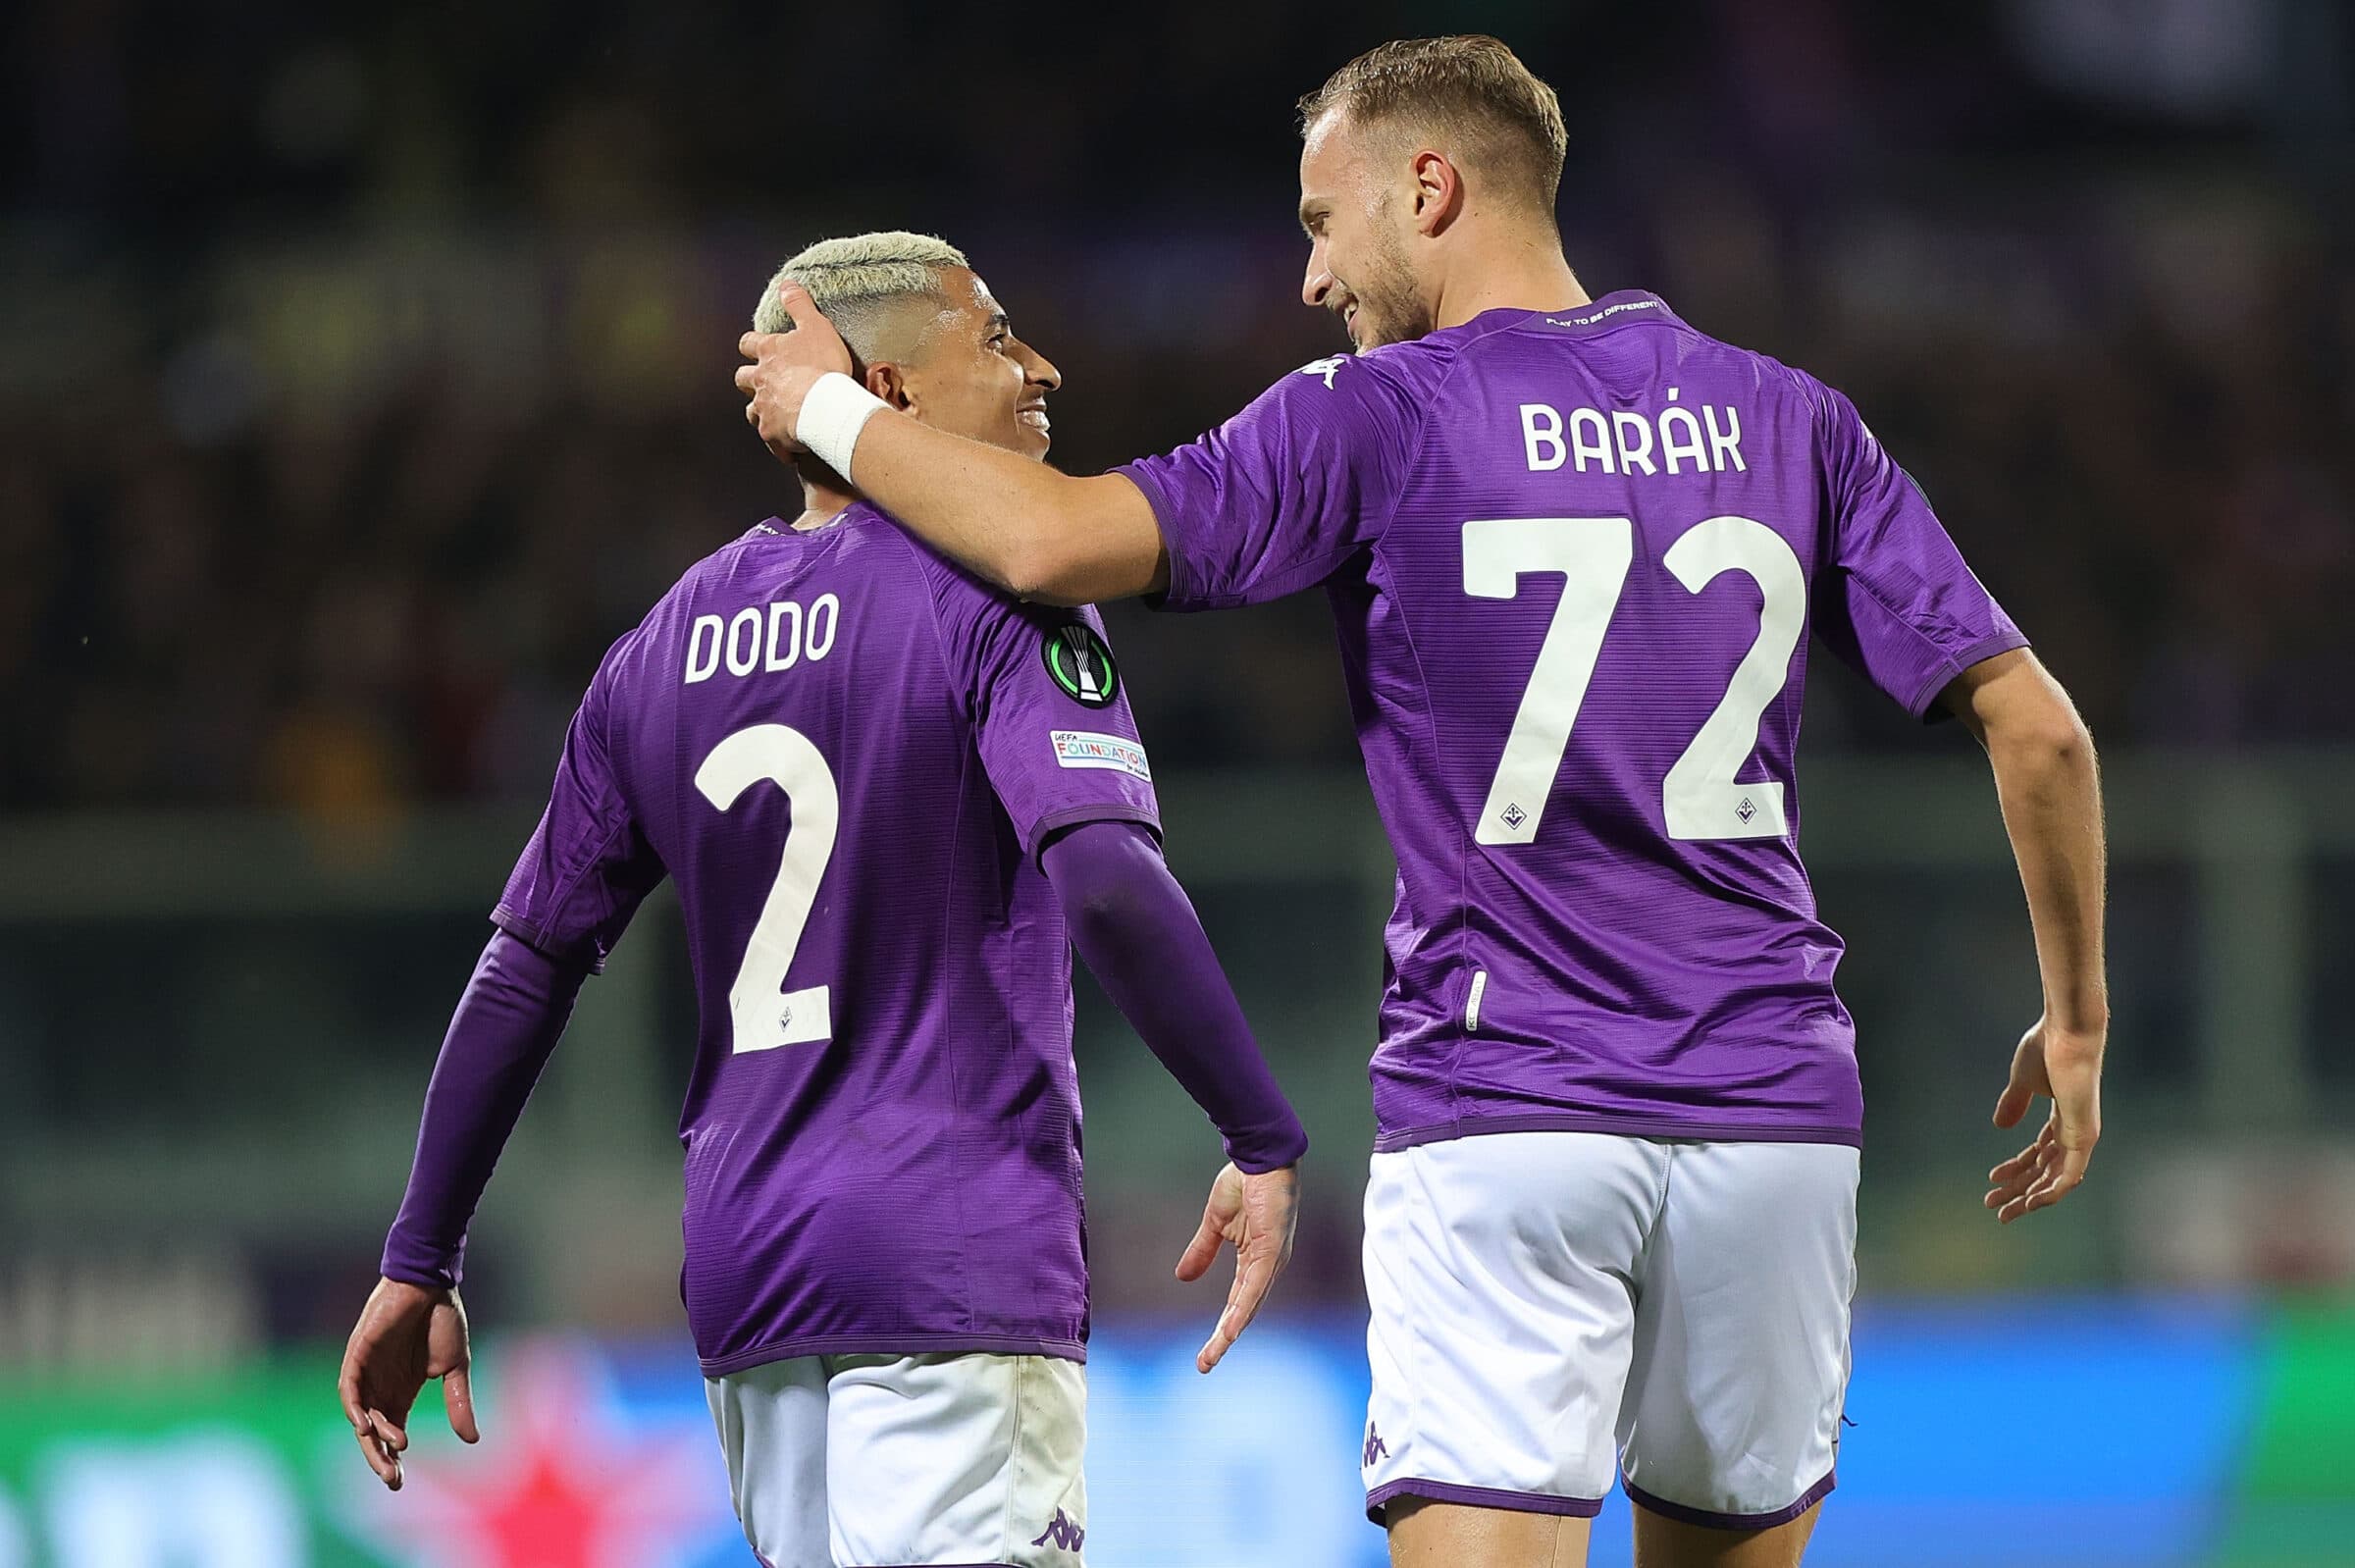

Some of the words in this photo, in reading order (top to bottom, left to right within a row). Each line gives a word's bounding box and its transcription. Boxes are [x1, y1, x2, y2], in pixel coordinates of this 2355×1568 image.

[1545, 318, 1572, 328] PLAY
[1590, 312, 1605, 324] BE
[1604, 301, 1658, 316] DIFFERENT
[1519, 388, 1747, 476] BARÁK
[684, 593, 840, 684] DODO
[1462, 515, 1806, 845] 72
[1054, 733, 1078, 742] UEFA
[1058, 743, 1147, 768] FOUNDATION
[694, 723, 839, 1054] 2
